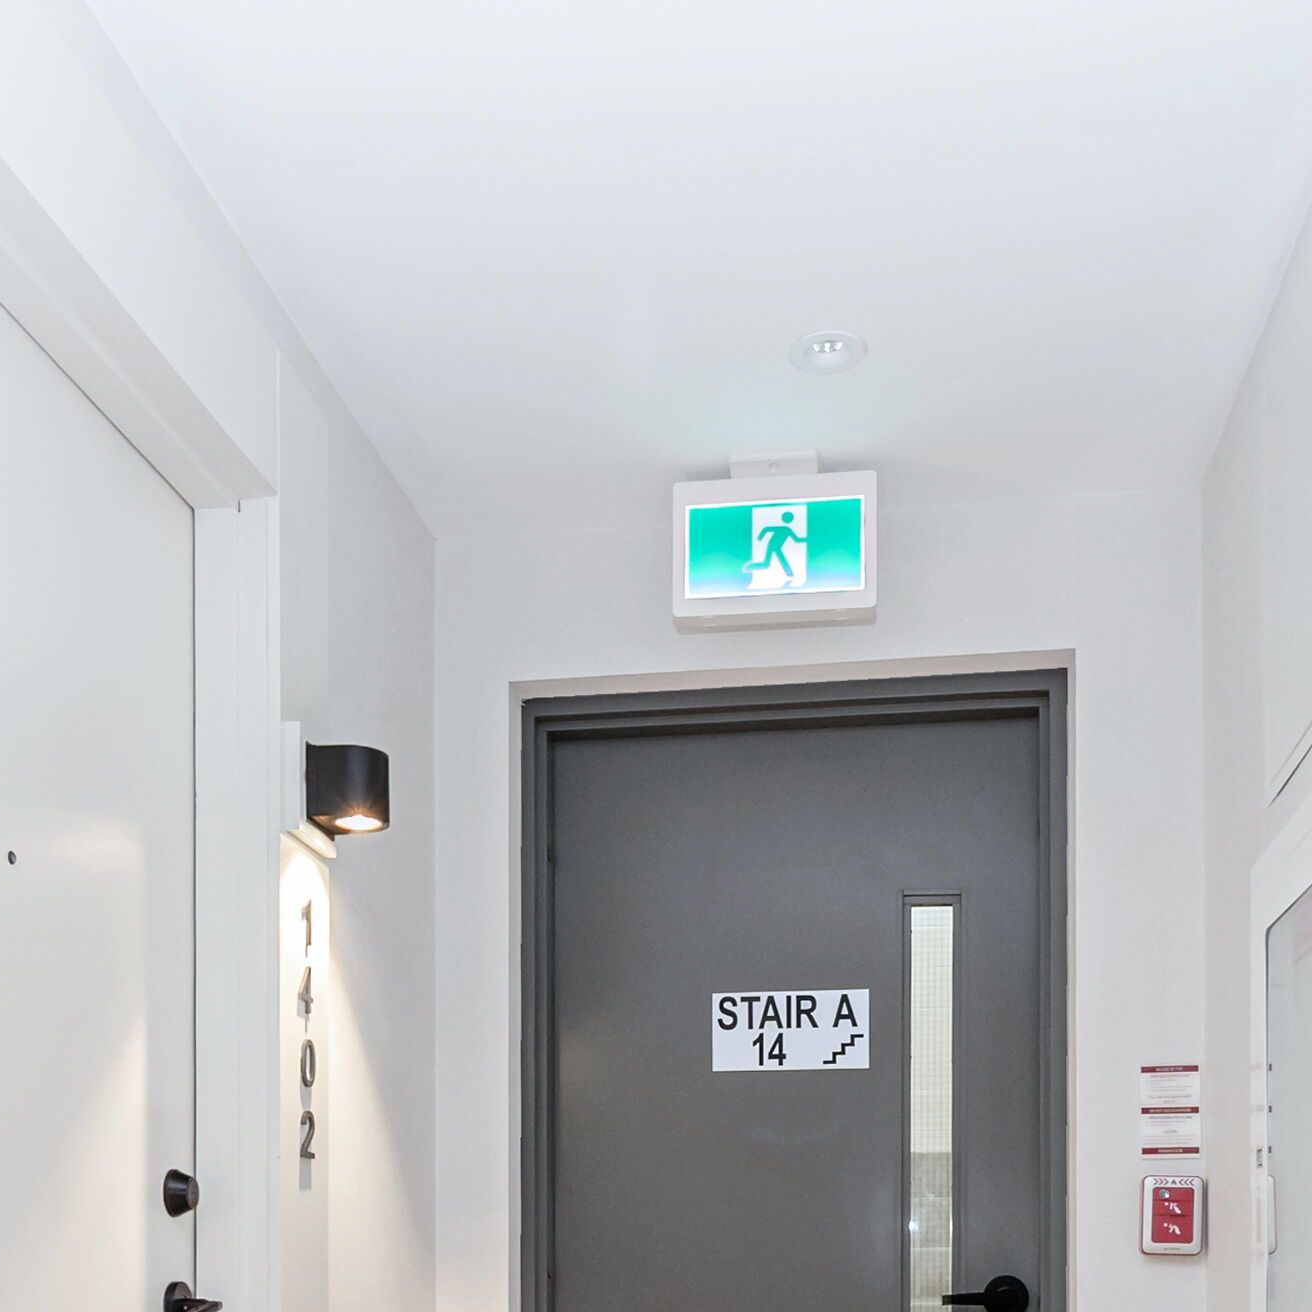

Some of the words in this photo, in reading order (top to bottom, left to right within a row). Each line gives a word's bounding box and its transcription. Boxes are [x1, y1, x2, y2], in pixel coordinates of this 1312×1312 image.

[717, 994, 819, 1030] STAIR
[832, 993, 858, 1028] A
[752, 1032, 787, 1066] 14
